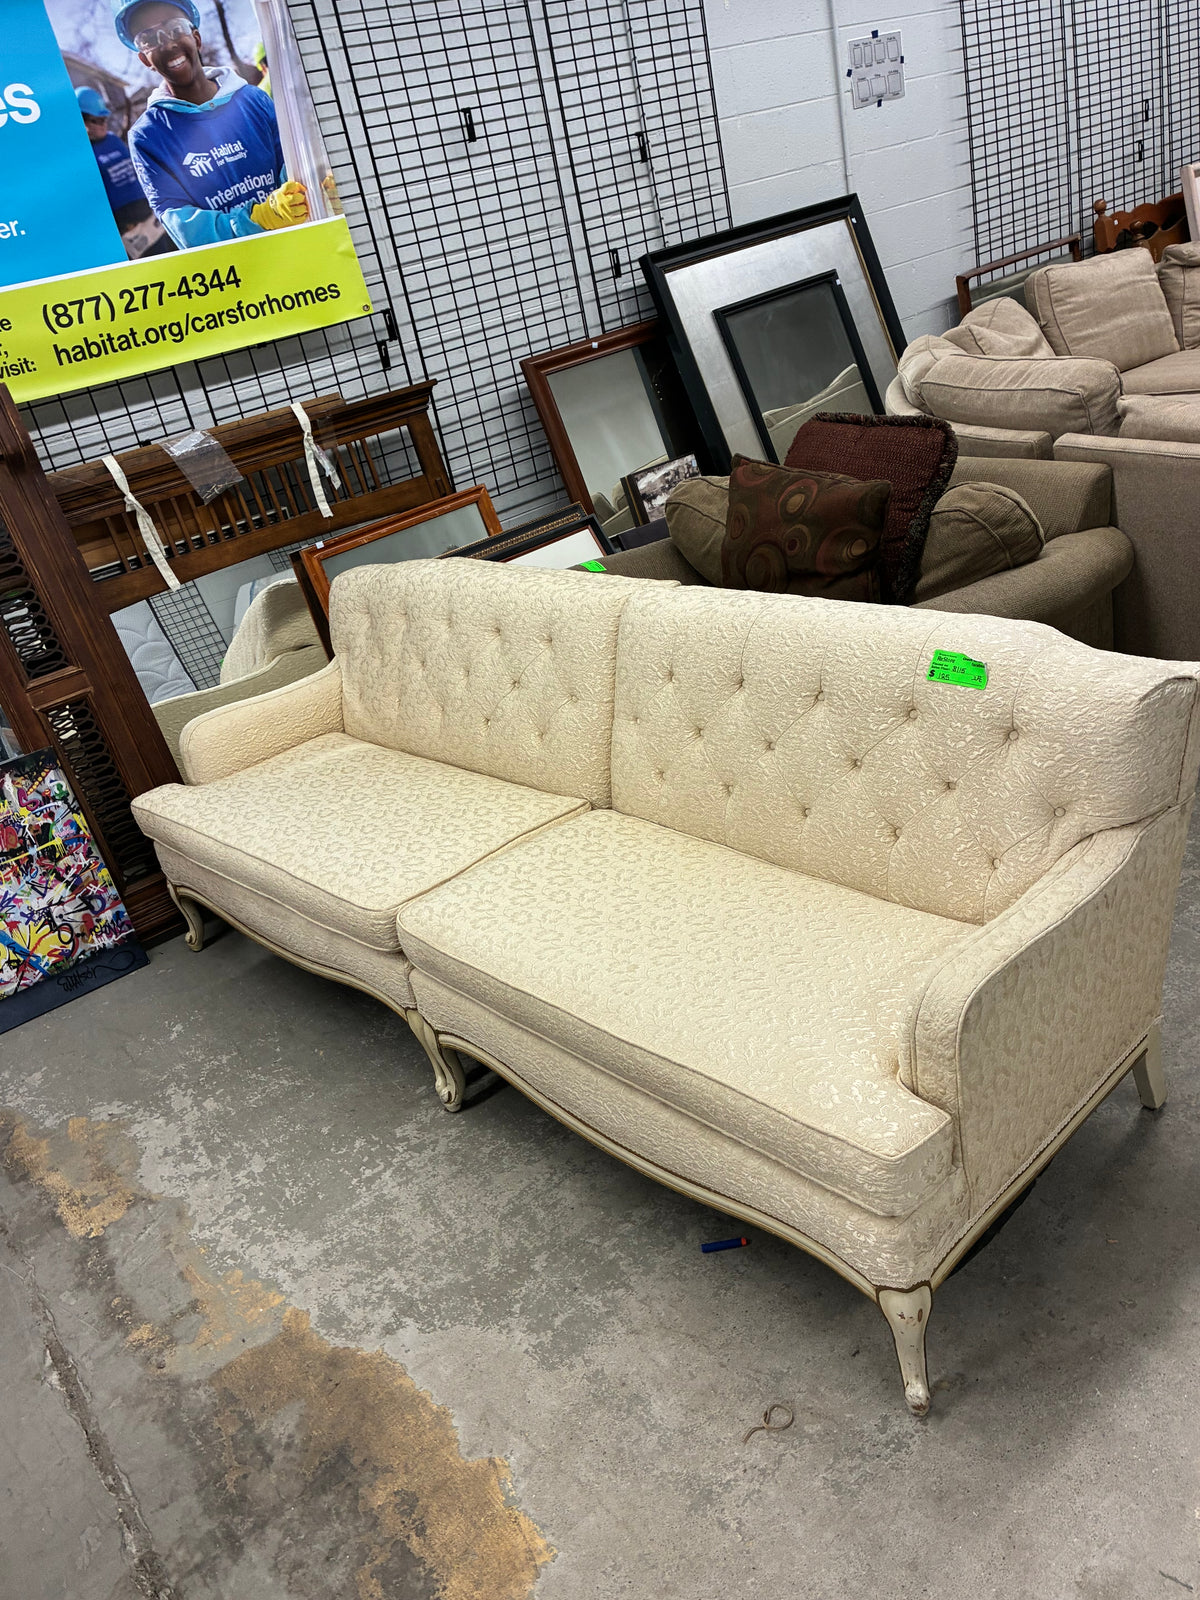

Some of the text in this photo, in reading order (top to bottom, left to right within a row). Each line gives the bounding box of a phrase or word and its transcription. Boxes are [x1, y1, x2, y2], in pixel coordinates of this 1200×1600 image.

[0, 83, 41, 128] s
[210, 140, 244, 160] Habitat
[216, 159, 225, 167] for
[205, 169, 275, 210] International
[42, 265, 242, 335] (877) 277-4344
[52, 283, 341, 367] habitat.org/carsforhomes
[928, 670, 935, 678] $
